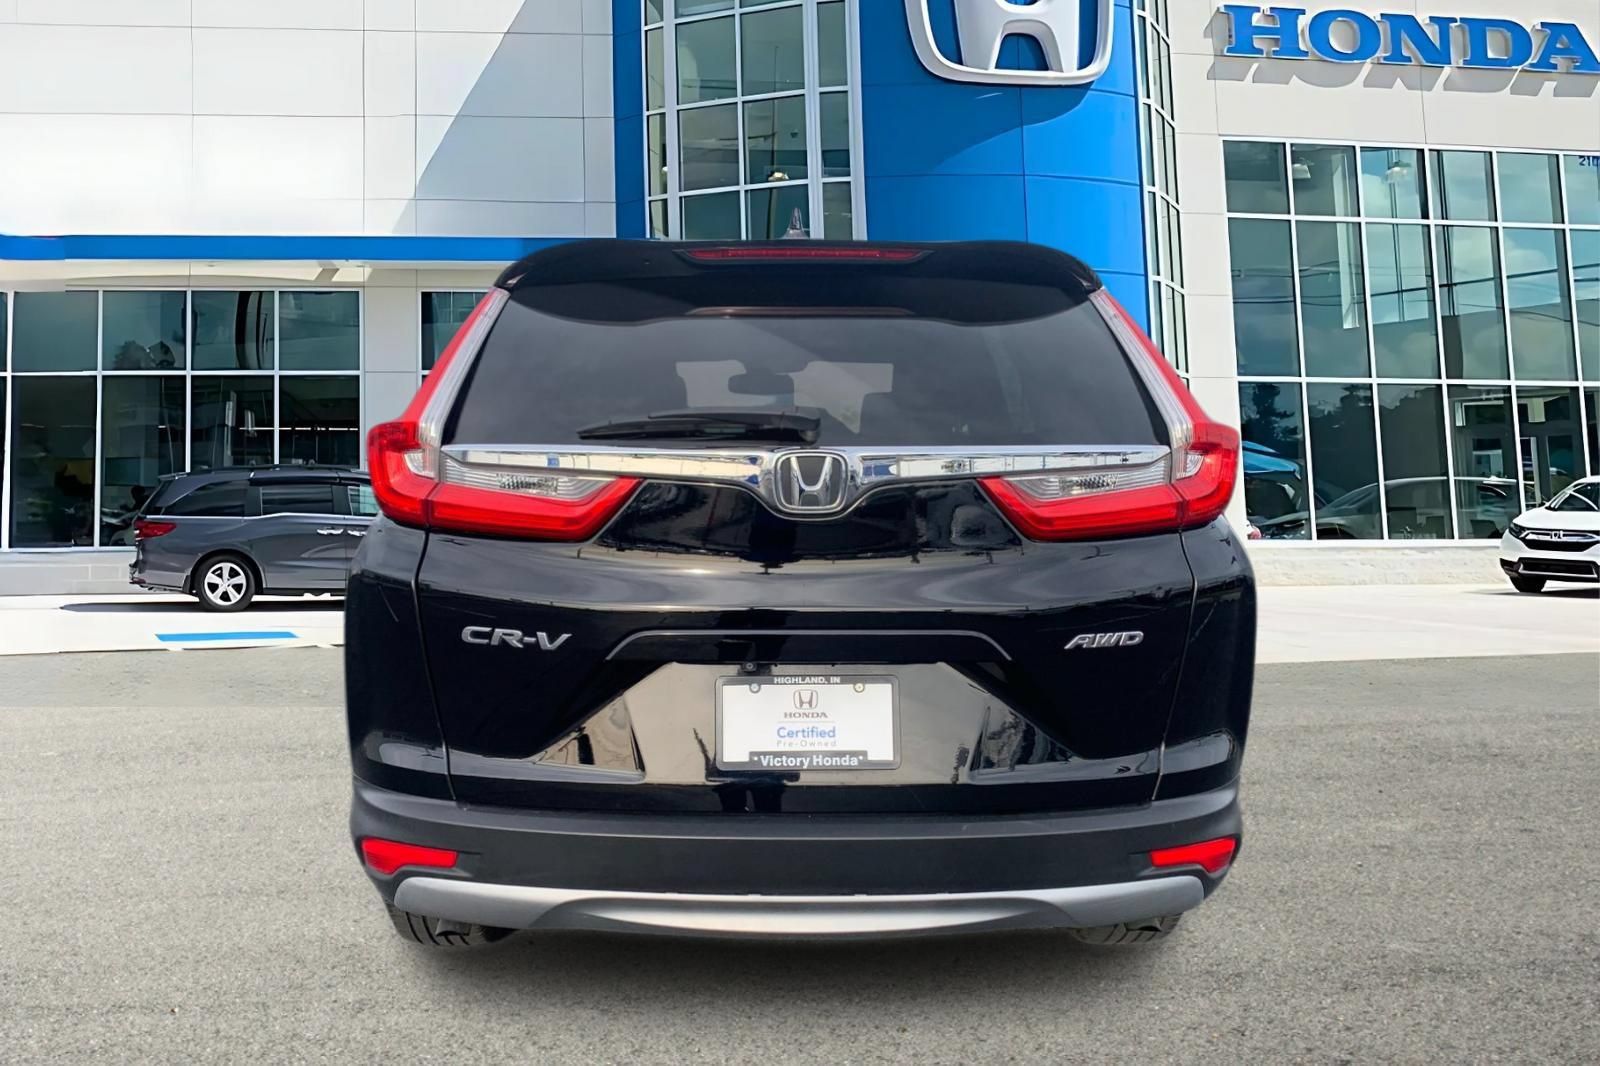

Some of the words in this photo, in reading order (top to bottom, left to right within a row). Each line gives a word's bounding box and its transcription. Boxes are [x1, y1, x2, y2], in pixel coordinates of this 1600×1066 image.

[1222, 4, 1600, 73] HONDA
[461, 625, 572, 650] CR-V
[1063, 630, 1144, 650] AWD
[776, 726, 837, 739] Certified
[776, 740, 837, 748] Pre-Owned
[760, 754, 810, 769] Victory
[812, 754, 859, 766] Honda
